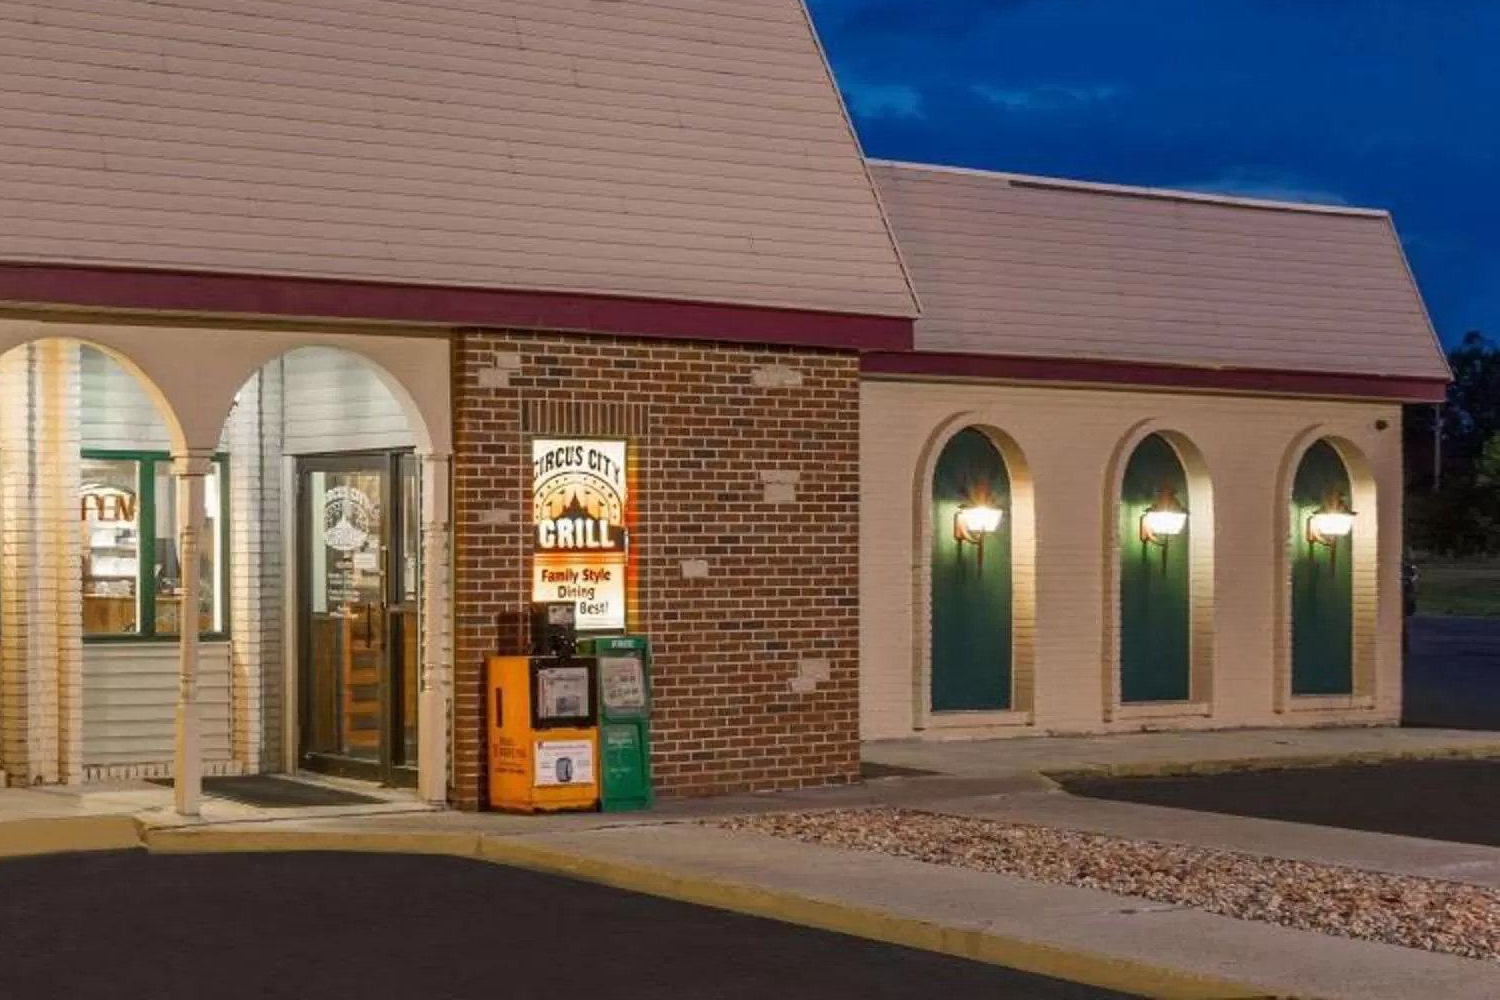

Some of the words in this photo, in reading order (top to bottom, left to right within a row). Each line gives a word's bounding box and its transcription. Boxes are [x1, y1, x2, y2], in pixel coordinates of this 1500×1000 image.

[588, 449, 620, 484] CITY
[81, 493, 136, 522] PEN
[539, 517, 615, 549] GRILL
[541, 567, 578, 583] Family
[582, 567, 611, 583] Style
[557, 585, 595, 600] Dining
